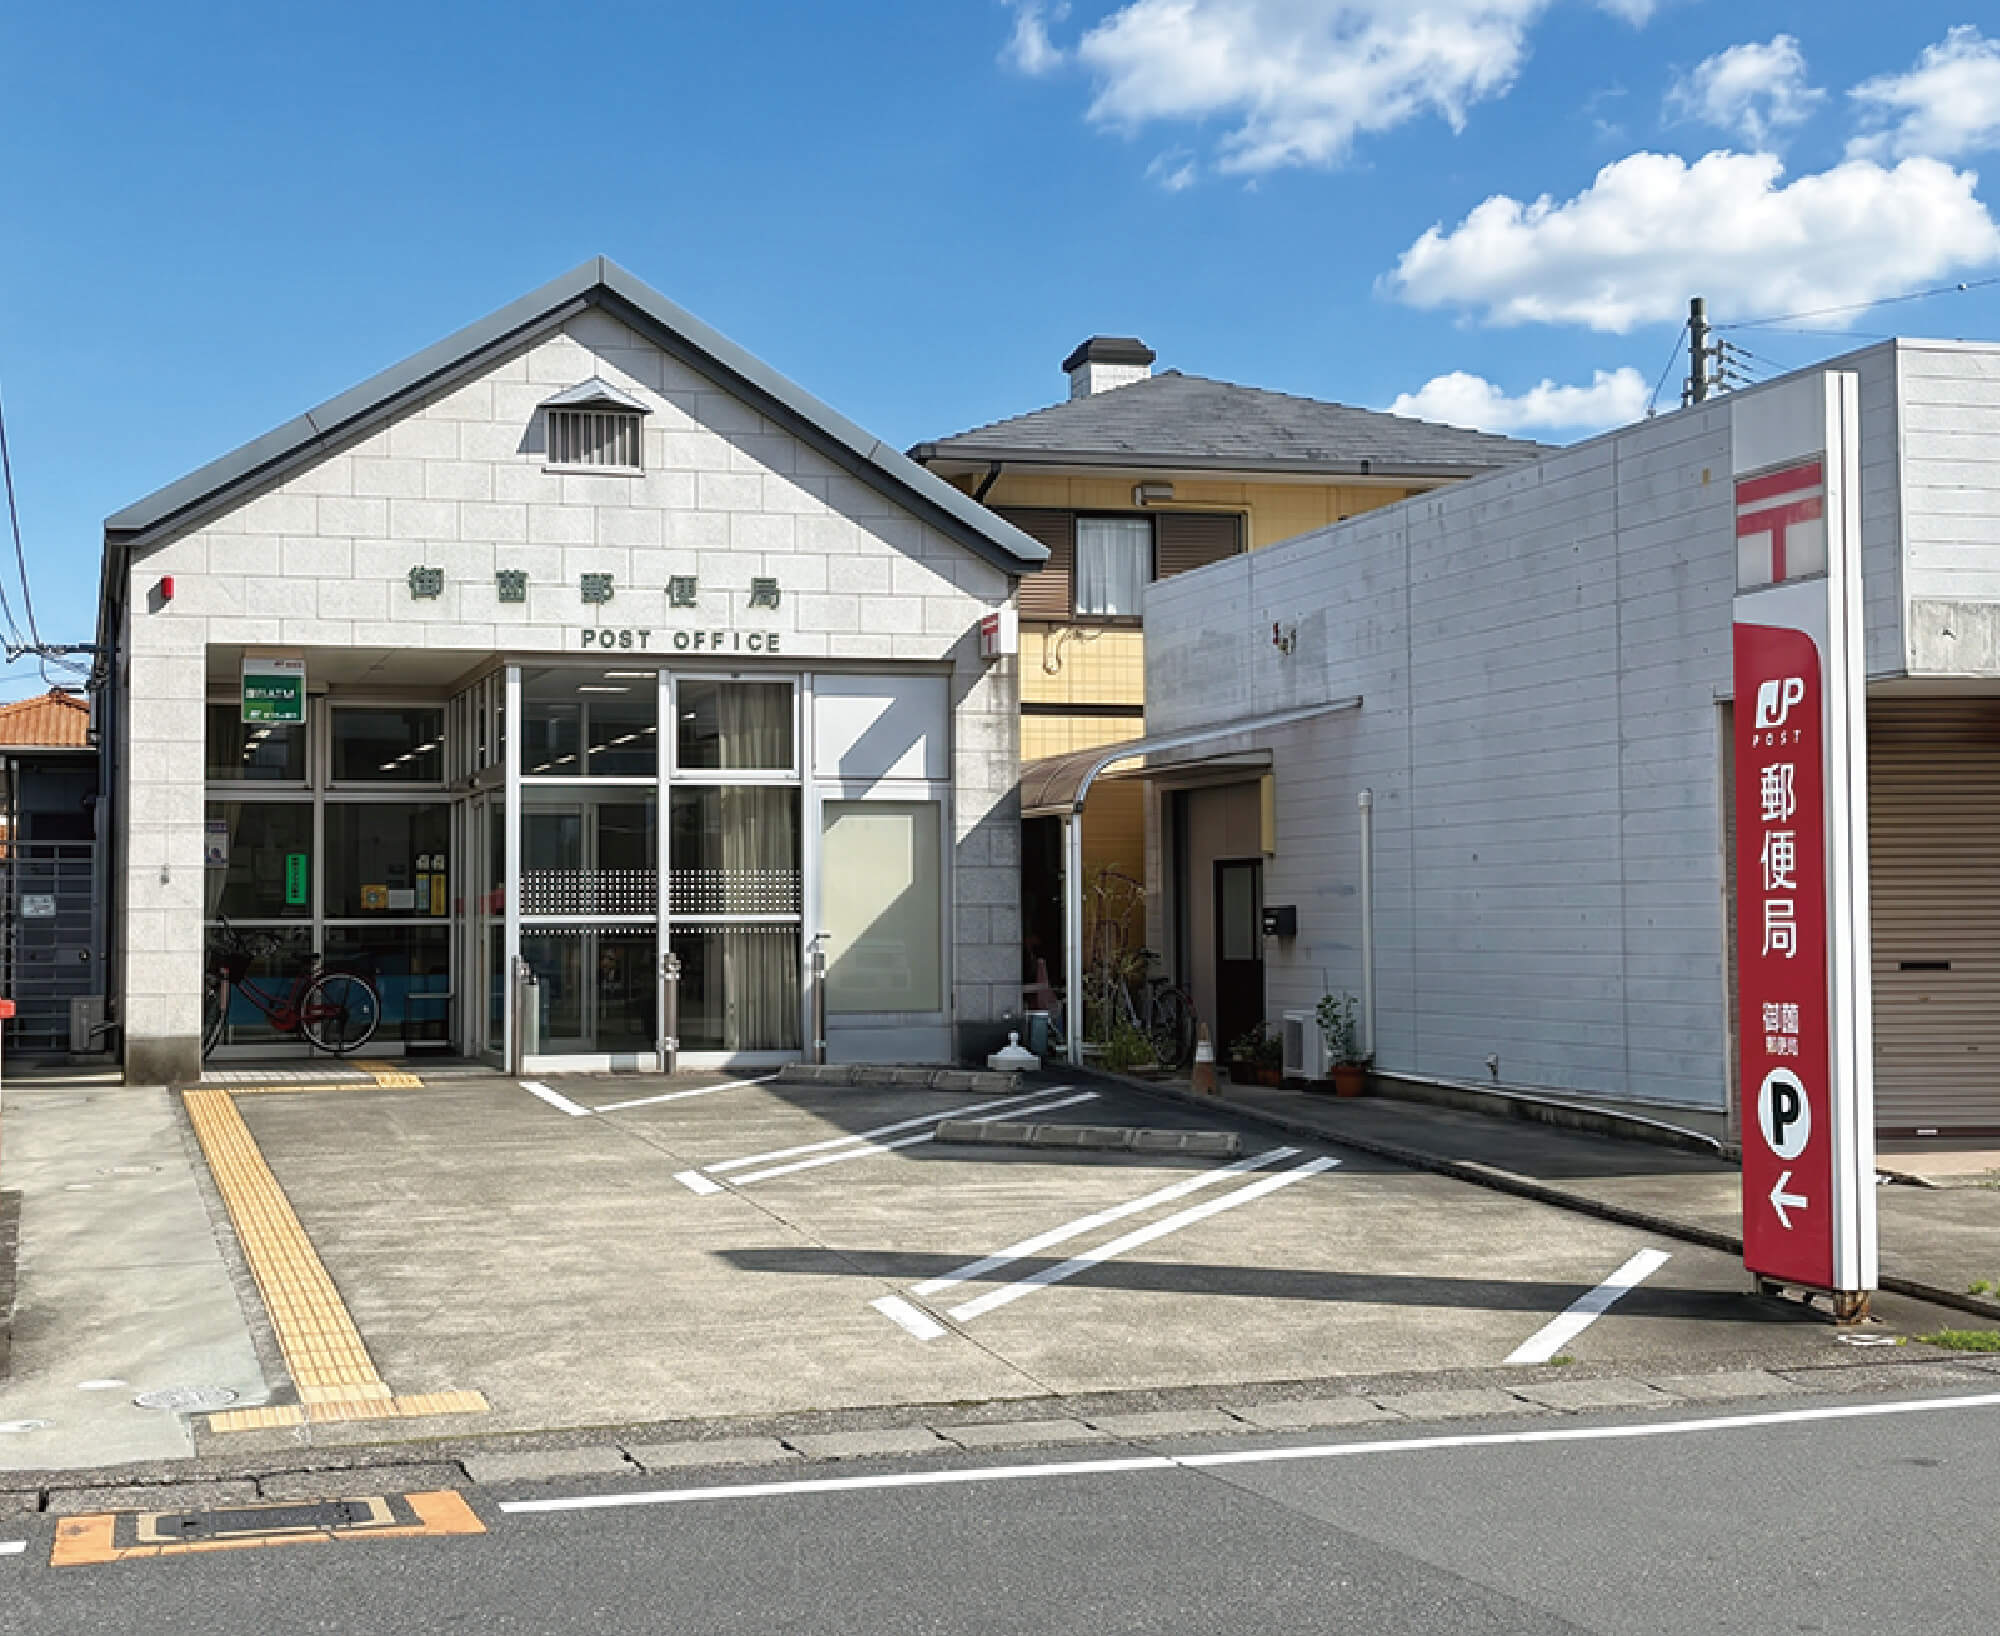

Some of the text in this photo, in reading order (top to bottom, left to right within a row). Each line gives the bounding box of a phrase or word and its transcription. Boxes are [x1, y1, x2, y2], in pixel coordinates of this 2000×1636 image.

[581, 629, 780, 653] POST OFFICE
[1752, 729, 1802, 749] POST
[1761, 763, 1797, 958] 郵便局
[1770, 1081, 1801, 1146] P
